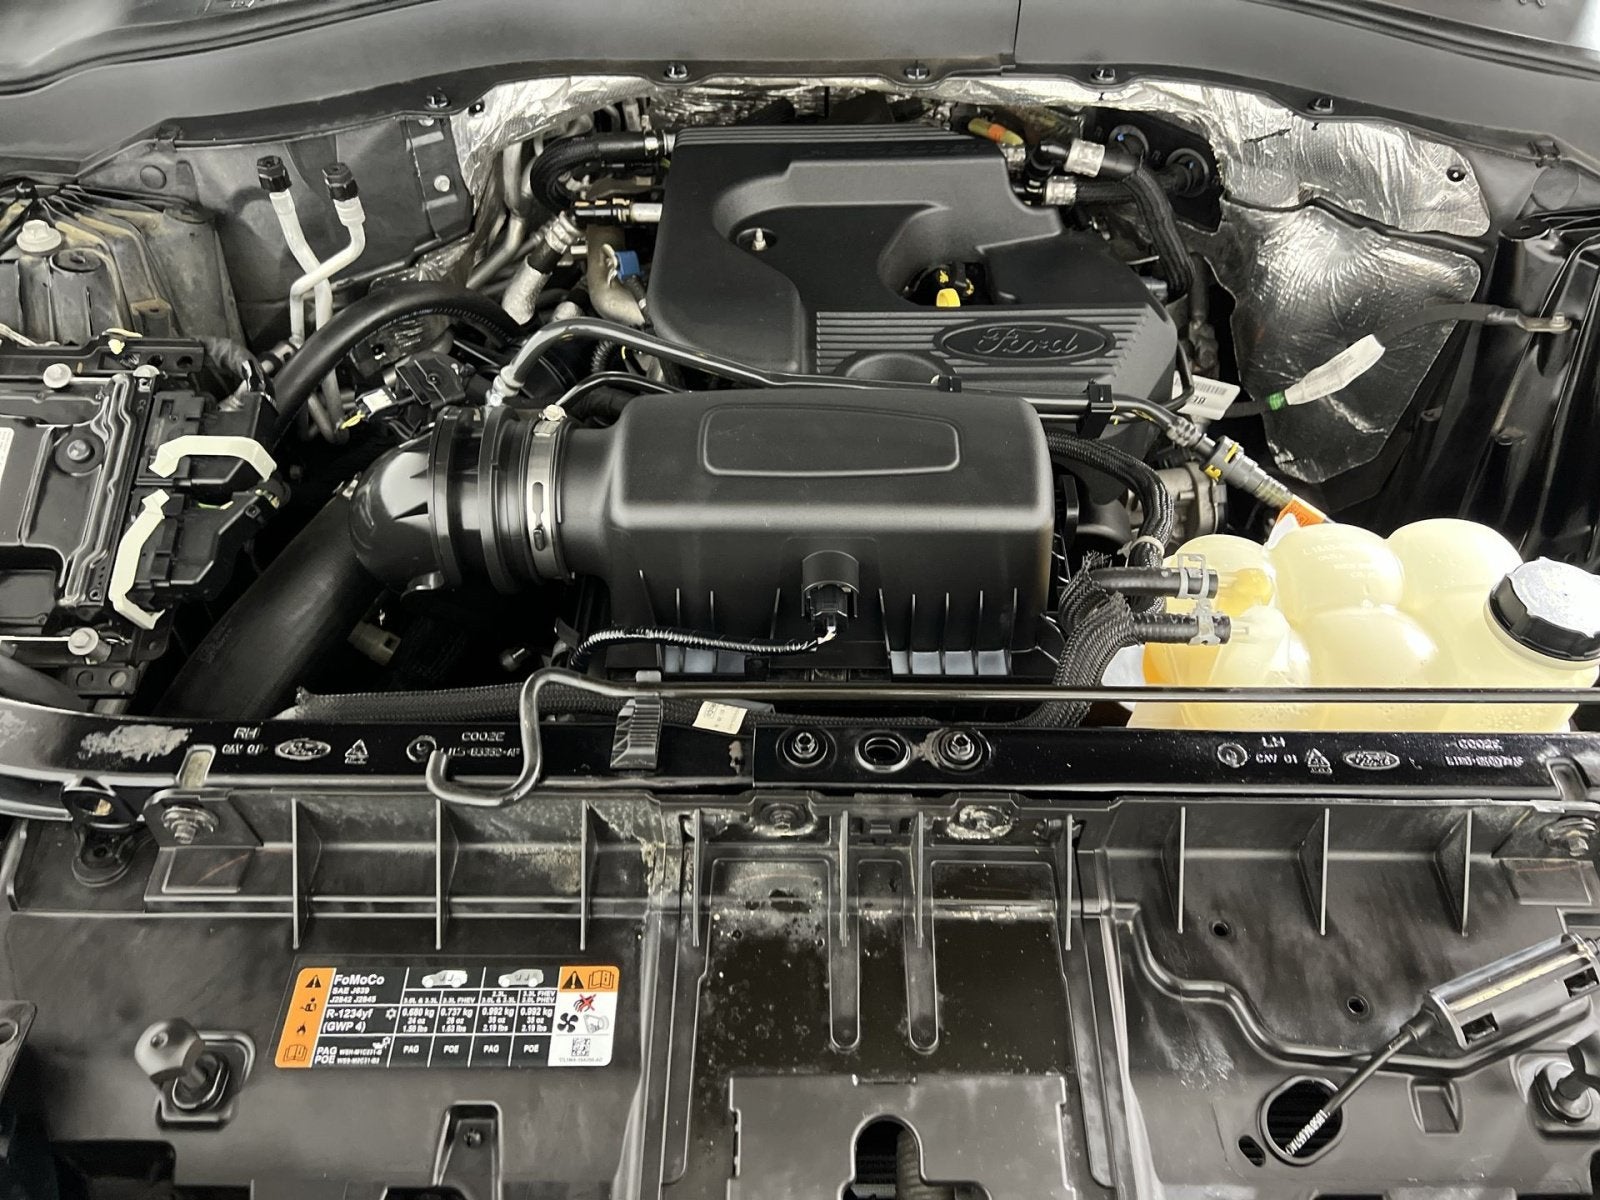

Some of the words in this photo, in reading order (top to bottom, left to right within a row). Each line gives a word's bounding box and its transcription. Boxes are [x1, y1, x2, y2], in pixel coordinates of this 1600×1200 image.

[974, 327, 1079, 354] Ford
[333, 973, 386, 986] FoMoCo
[332, 986, 350, 995] SAE
[326, 1008, 374, 1020] R-1234yf
[424, 1007, 435, 1018] kg
[440, 1007, 462, 1017] 0.737
[462, 1007, 474, 1018] kg
[503, 1006, 515, 1017] kg
[542, 1006, 553, 1017] kg
[322, 1021, 354, 1034] (GWP
[354, 1021, 367, 1034] 4)
[316, 1046, 338, 1055] PAG
[402, 1044, 420, 1054] PAG
[443, 1044, 460, 1054] POE
[483, 1044, 500, 1053] PAG
[523, 1044, 540, 1053] POE
[314, 1055, 336, 1064] POE
